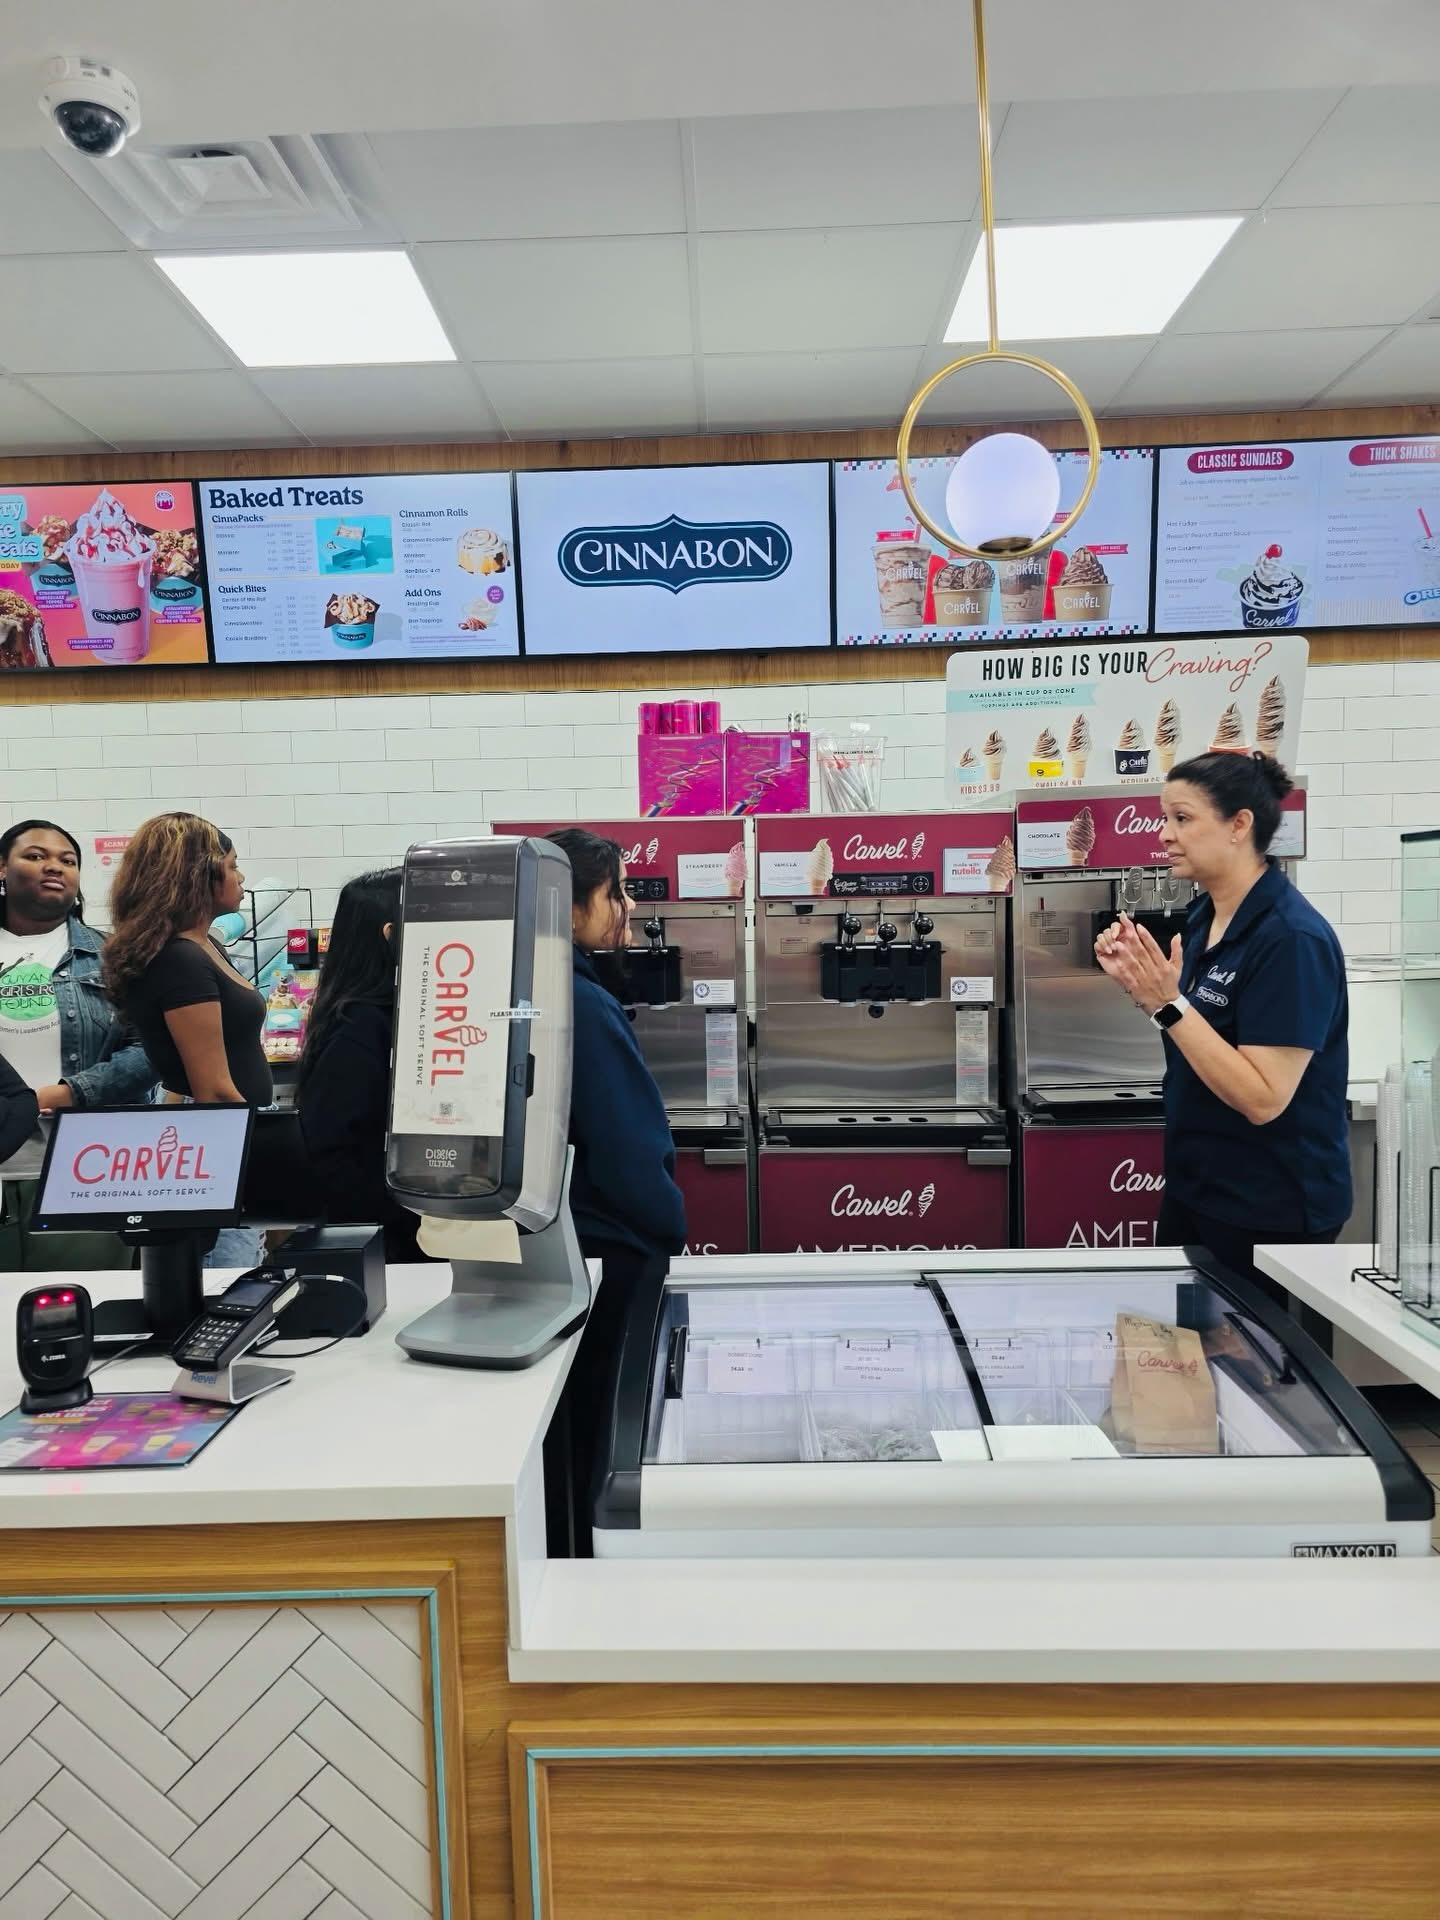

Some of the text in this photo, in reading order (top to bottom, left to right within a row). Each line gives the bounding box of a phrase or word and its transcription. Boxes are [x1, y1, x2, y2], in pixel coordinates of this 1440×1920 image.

[1197, 451, 1283, 469] CLASSIC SUNDAES
[1369, 445, 1436, 461] THICK SHAKES
[209, 486, 363, 509] Baked Treats
[212, 514, 264, 523] CinnaPacks
[399, 508, 469, 518] Cinnamon Rolls
[574, 537, 774, 574] CINNABON
[886, 561, 924, 580] CARVEL
[1006, 560, 1044, 576] CARVEL
[218, 584, 267, 594] Quick Bites
[405, 588, 442, 597] Add Ons
[943, 598, 981, 615] CARVEL
[1063, 593, 1100, 610] CARVEL
[94, 611, 138, 621] CINNABON
[1246, 608, 1294, 628] Carvel
[982, 641, 1273, 692] HOW BIG IS YOUR Craving?
[969, 691, 1012, 699] AVAILABLE
[960, 783, 1000, 795] KIDS $3.99
[1114, 805, 1167, 835] Carv
[843, 834, 904, 861] Carvel
[952, 866, 982, 875] nutella
[2, 972, 49, 985] GUYAN
[0, 984, 34, 997] GIRLS
[415, 946, 431, 1086] THE ORIGINAL SOFT SERVE
[431, 943, 475, 1087] CARVEL
[73, 1142, 210, 1185] CARVEL
[1110, 1158, 1166, 1192] Carv
[70, 1187, 207, 1199] THE ORIGINAL SOFT SERVE
[831, 1183, 910, 1217] Carvel
